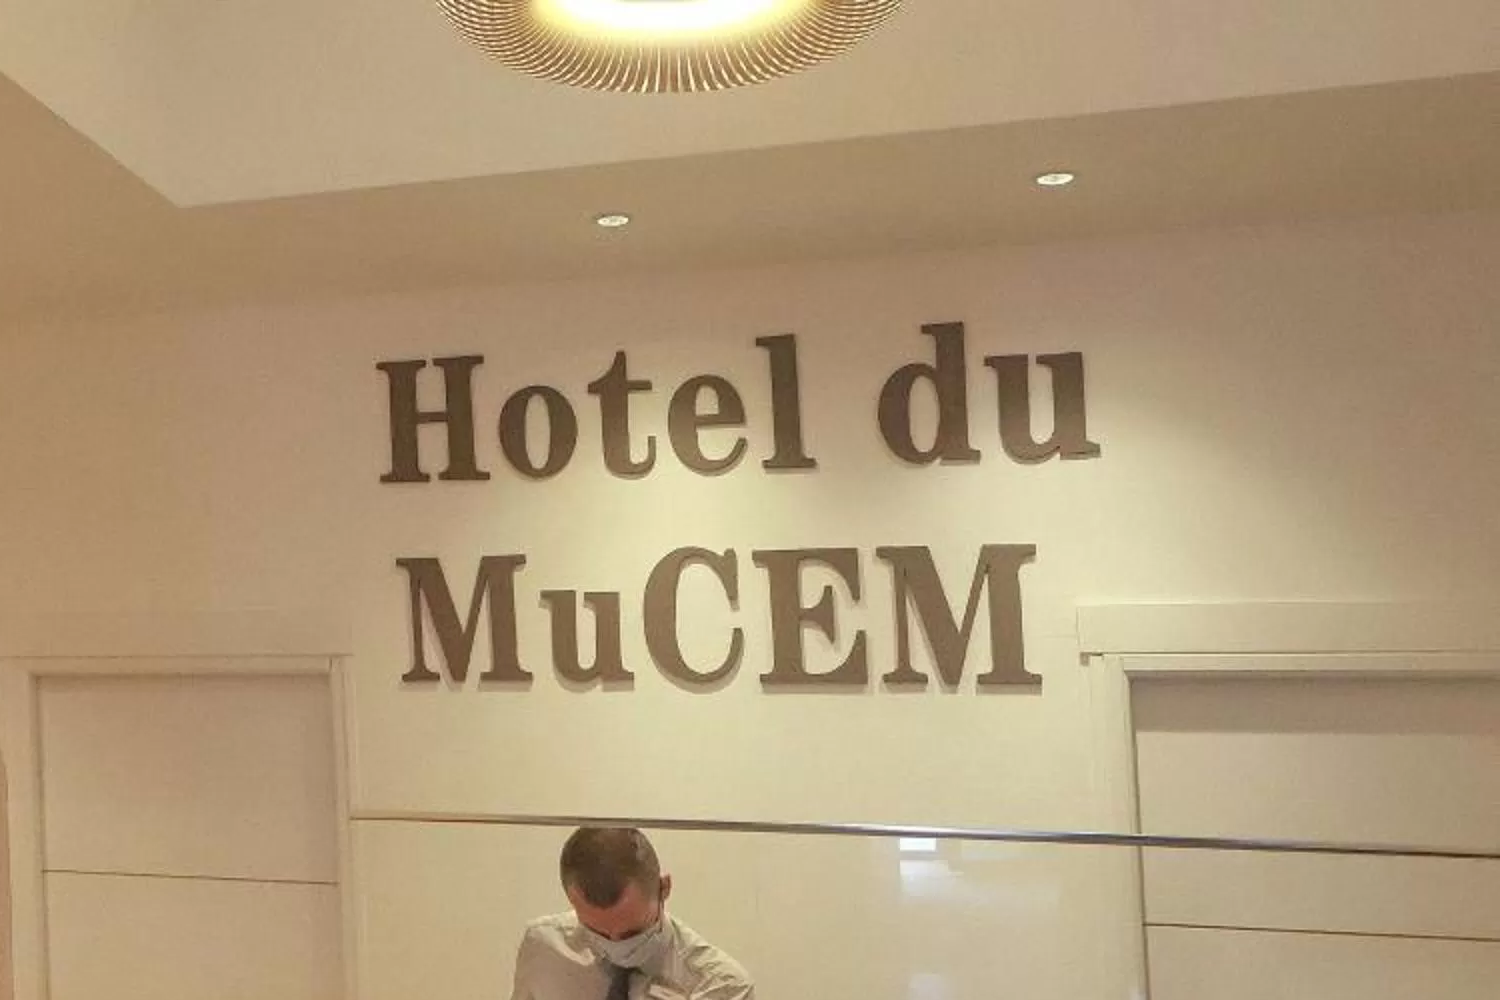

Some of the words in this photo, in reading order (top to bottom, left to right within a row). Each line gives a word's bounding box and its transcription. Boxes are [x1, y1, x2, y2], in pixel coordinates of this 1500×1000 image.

[376, 333, 817, 483] Hotel
[877, 321, 1101, 465] du
[396, 544, 1043, 693] MuCEM
